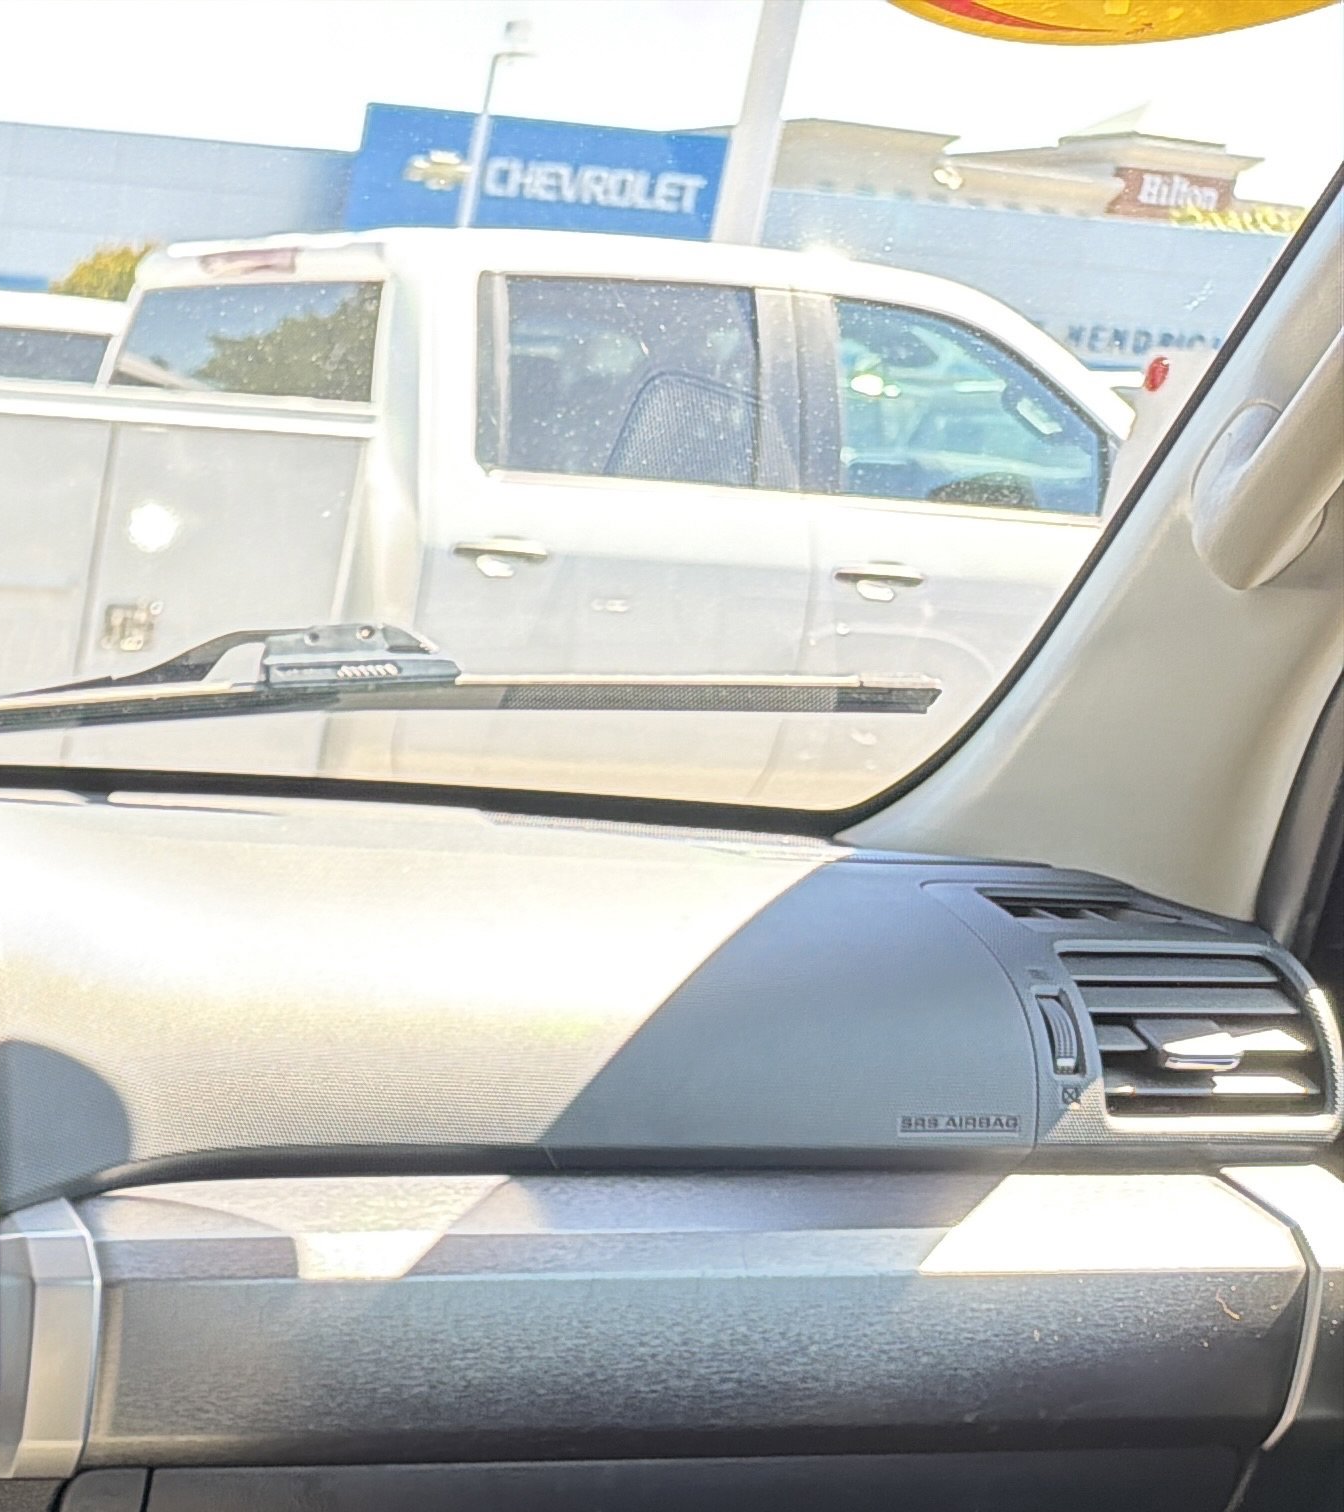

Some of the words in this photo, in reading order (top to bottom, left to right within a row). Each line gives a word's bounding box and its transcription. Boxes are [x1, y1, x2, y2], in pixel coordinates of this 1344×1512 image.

[482, 156, 708, 215] CHEVROLET
[1138, 173, 1219, 210] Hilton
[901, 1116, 938, 1129] SRS
[945, 1116, 1018, 1130] AIRBAG
